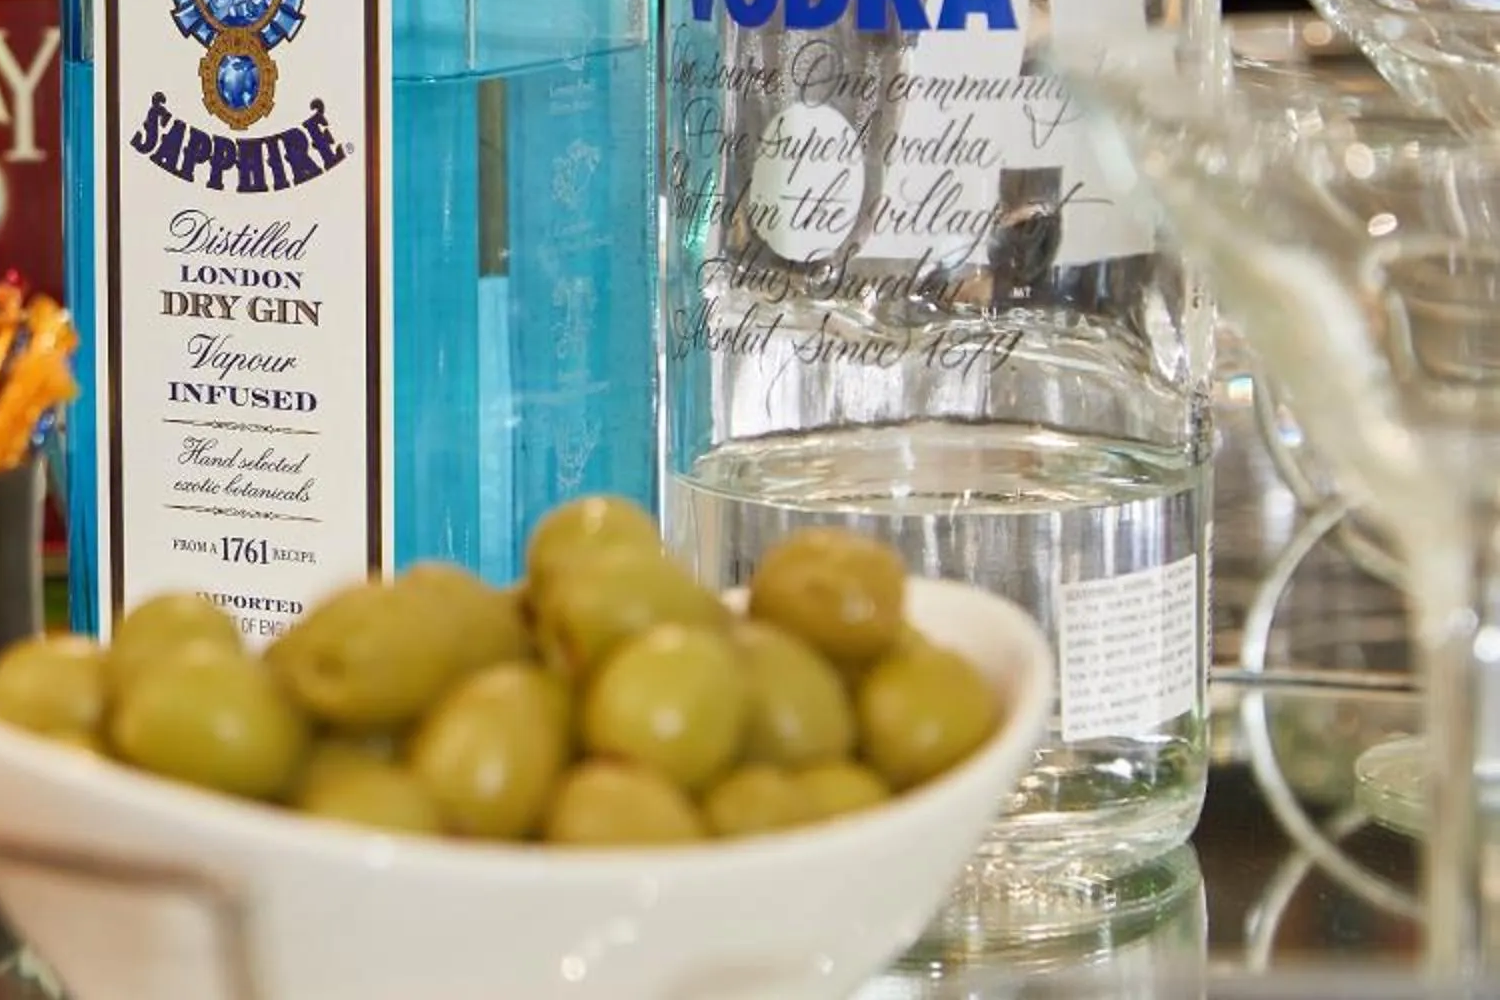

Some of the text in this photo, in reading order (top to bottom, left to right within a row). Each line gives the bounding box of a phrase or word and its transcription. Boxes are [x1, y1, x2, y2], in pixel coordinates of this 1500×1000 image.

[792, 39, 879, 108] One
[130, 91, 347, 193] SAPPHIRE
[780, 166, 850, 235] the
[164, 208, 319, 262] Distilled
[180, 264, 304, 290] LONDON
[160, 290, 323, 327] DRY GIN
[187, 333, 297, 380] Vapour
[790, 312, 913, 368] Since
[168, 381, 317, 412] INFUSED
[178, 437, 311, 475] Hand selected
[173, 473, 318, 503] exotic botanicals
[173, 539, 208, 554] FROM
[209, 542, 218, 555] A
[220, 536, 269, 565] 1761
[196, 591, 304, 616] MPORTED
